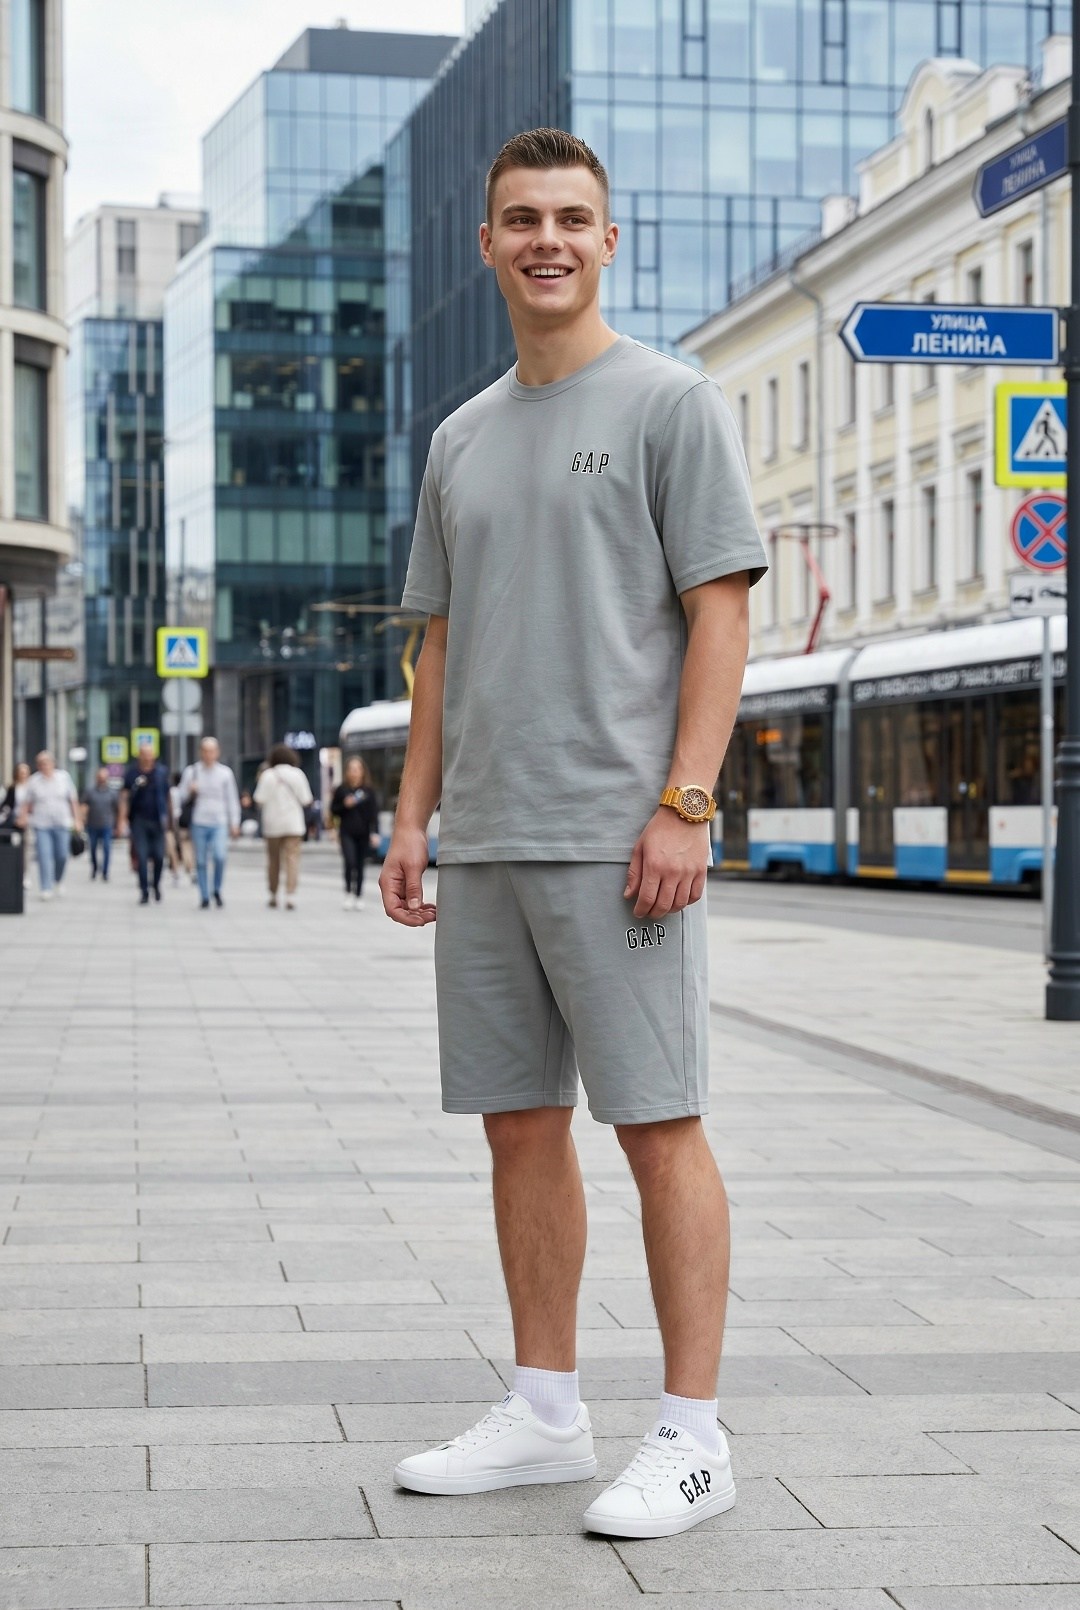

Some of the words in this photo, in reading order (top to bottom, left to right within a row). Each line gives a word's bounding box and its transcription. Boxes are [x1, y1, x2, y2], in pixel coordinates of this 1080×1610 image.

[931, 314, 987, 333] УЛИЦА
[912, 332, 1006, 356] ЛЕНИНА
[571, 451, 610, 475] GAP
[626, 923, 667, 950] GAP
[658, 1426, 678, 1440] GAP
[679, 1469, 711, 1504] GAP
